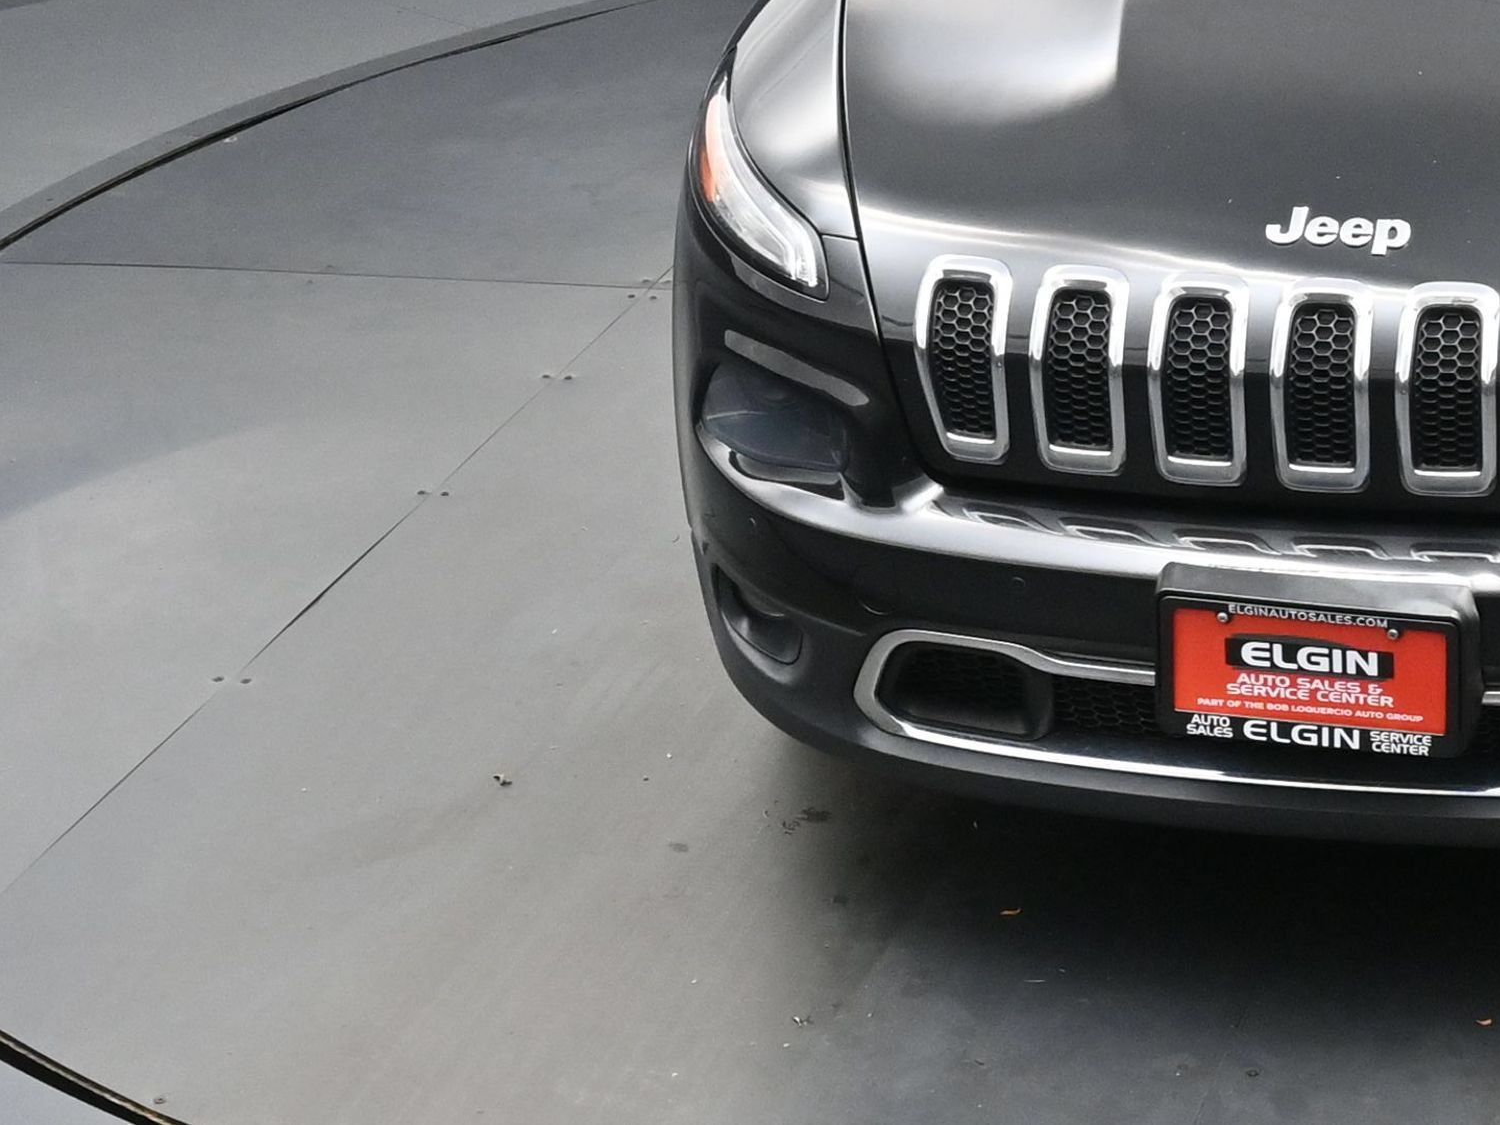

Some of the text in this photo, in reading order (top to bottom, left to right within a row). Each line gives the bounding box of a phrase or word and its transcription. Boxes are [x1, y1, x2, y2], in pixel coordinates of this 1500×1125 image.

[1265, 206, 1411, 256] Jeep
[1228, 604, 1388, 629] ELGINAUTOSALES.COM
[1241, 641, 1378, 677] ELGIN
[1226, 683, 1394, 708] SERVICE CENTER
[1237, 673, 1383, 695] AUTO SALES &
[1191, 714, 1230, 727] AUTO
[1197, 698, 1424, 723] PART OF THE BOB LOQUERCIO AUTO GROUP
[1186, 724, 1234, 738] SALES
[1243, 720, 1360, 750] ELGIN
[1370, 731, 1432, 746] SERVICE
[1372, 742, 1429, 756] CENTER
